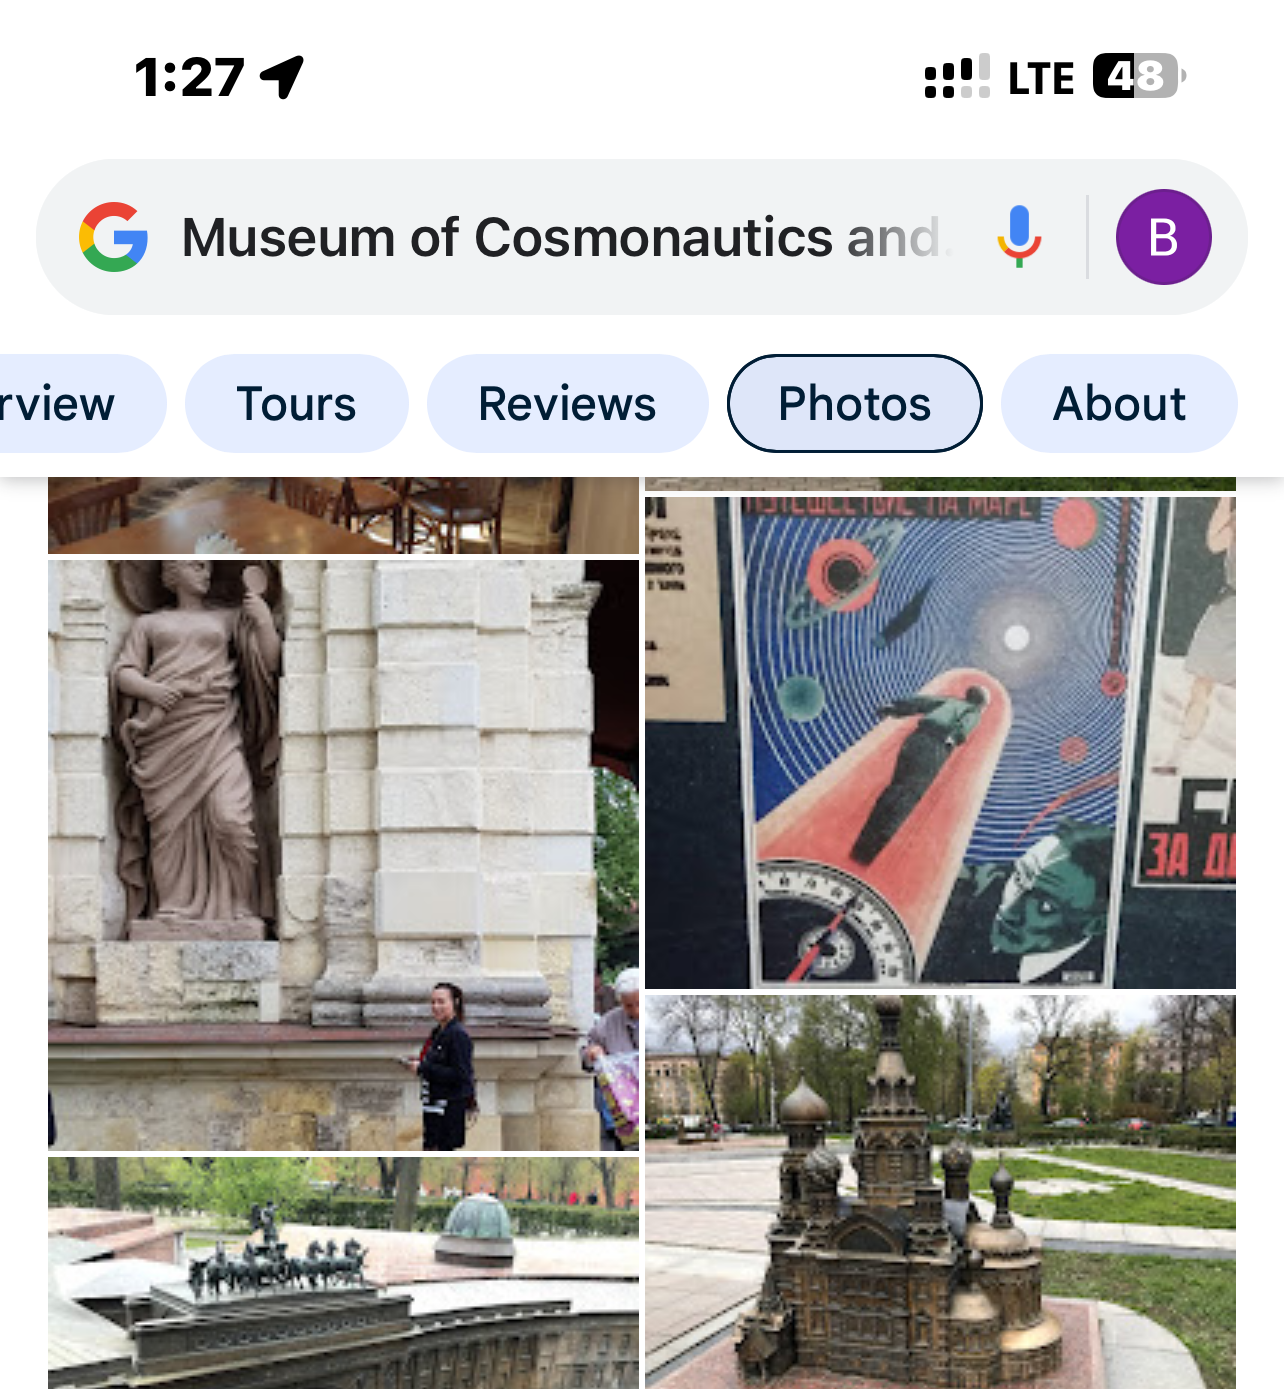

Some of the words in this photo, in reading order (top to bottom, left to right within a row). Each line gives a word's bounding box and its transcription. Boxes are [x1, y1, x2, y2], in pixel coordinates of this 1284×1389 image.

[135, 56, 245, 97] 1:27
[1009, 61, 1074, 95] LTE
[1107, 59, 1165, 92] 48
[183, 217, 395, 258] Museum
[410, 215, 460, 258] of
[475, 214, 833, 258] Cosmonautics
[1150, 217, 1178, 257] B
[236, 385, 357, 422] Tours
[480, 382, 656, 422] Reviews
[780, 382, 932, 422] Photos
[1052, 382, 1187, 422] About
[1145, 832, 1189, 876] ЗА
